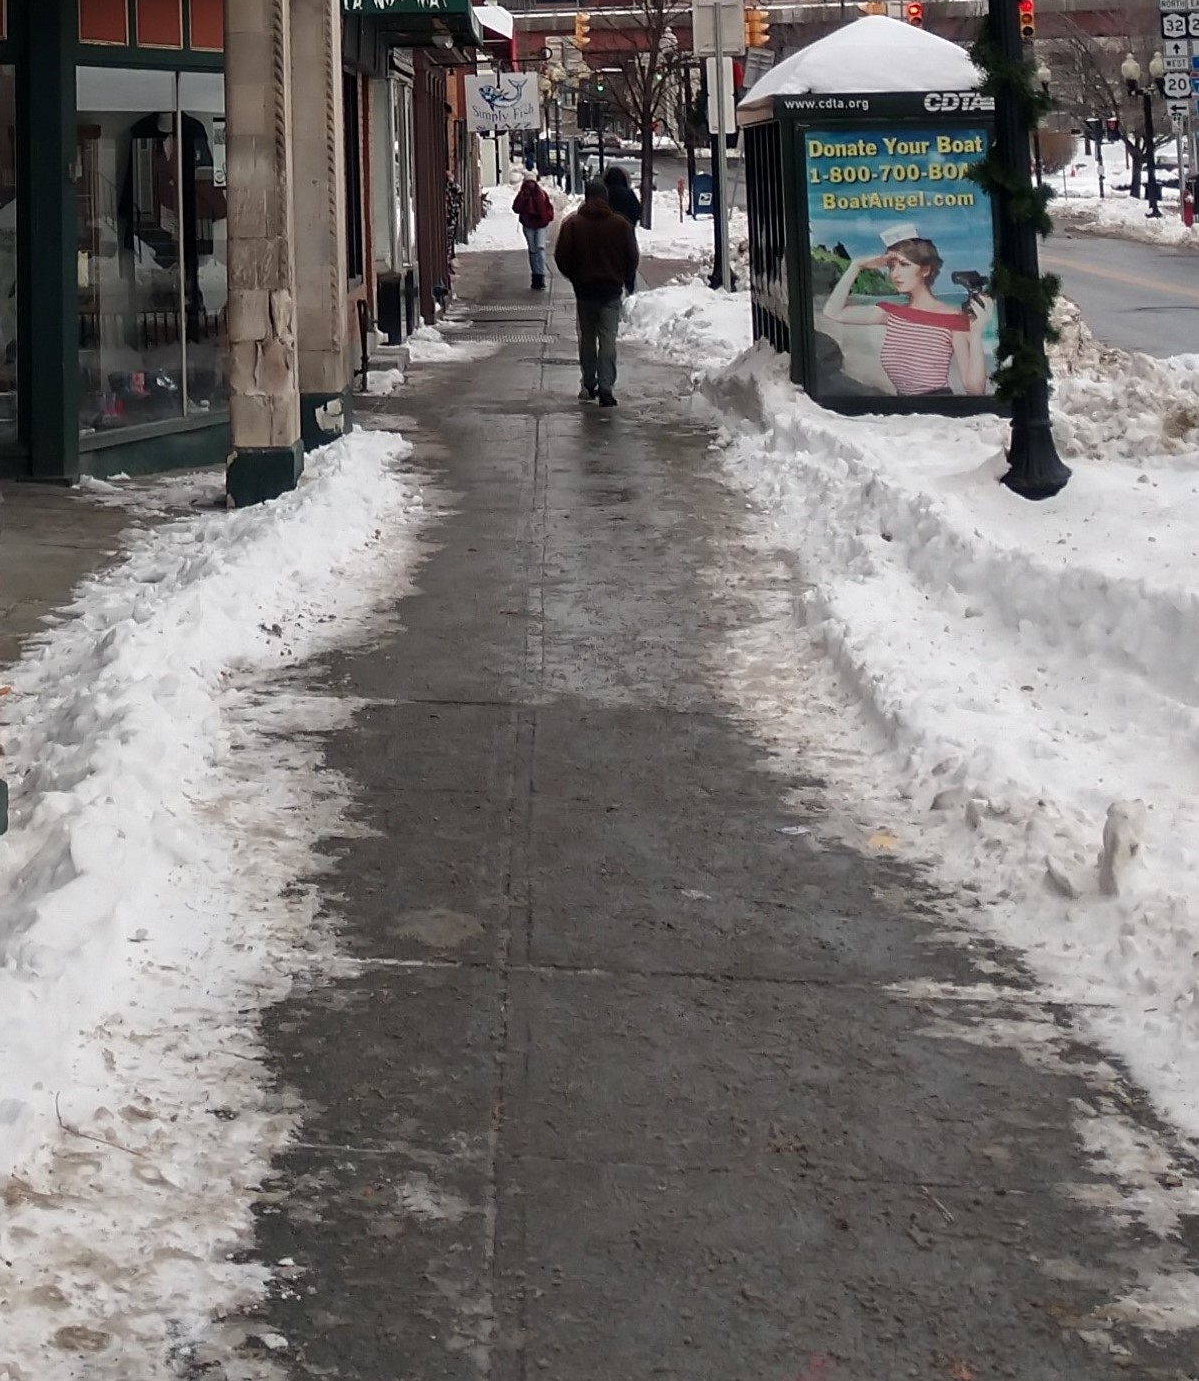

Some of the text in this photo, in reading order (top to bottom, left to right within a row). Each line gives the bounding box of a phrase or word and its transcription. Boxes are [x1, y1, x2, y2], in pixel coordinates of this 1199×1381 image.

[1166, 19, 1183, 32] 32
[1166, 59, 1186, 67] WEST
[1168, 78, 1187, 91] 20
[784, 98, 869, 111] www.cdta.org
[924, 92, 995, 111] CDTA
[808, 135, 983, 157] Donate Your Boat
[809, 163, 971, 184] 1-800-700-BOA
[822, 191, 975, 212] BoatAngel.com
